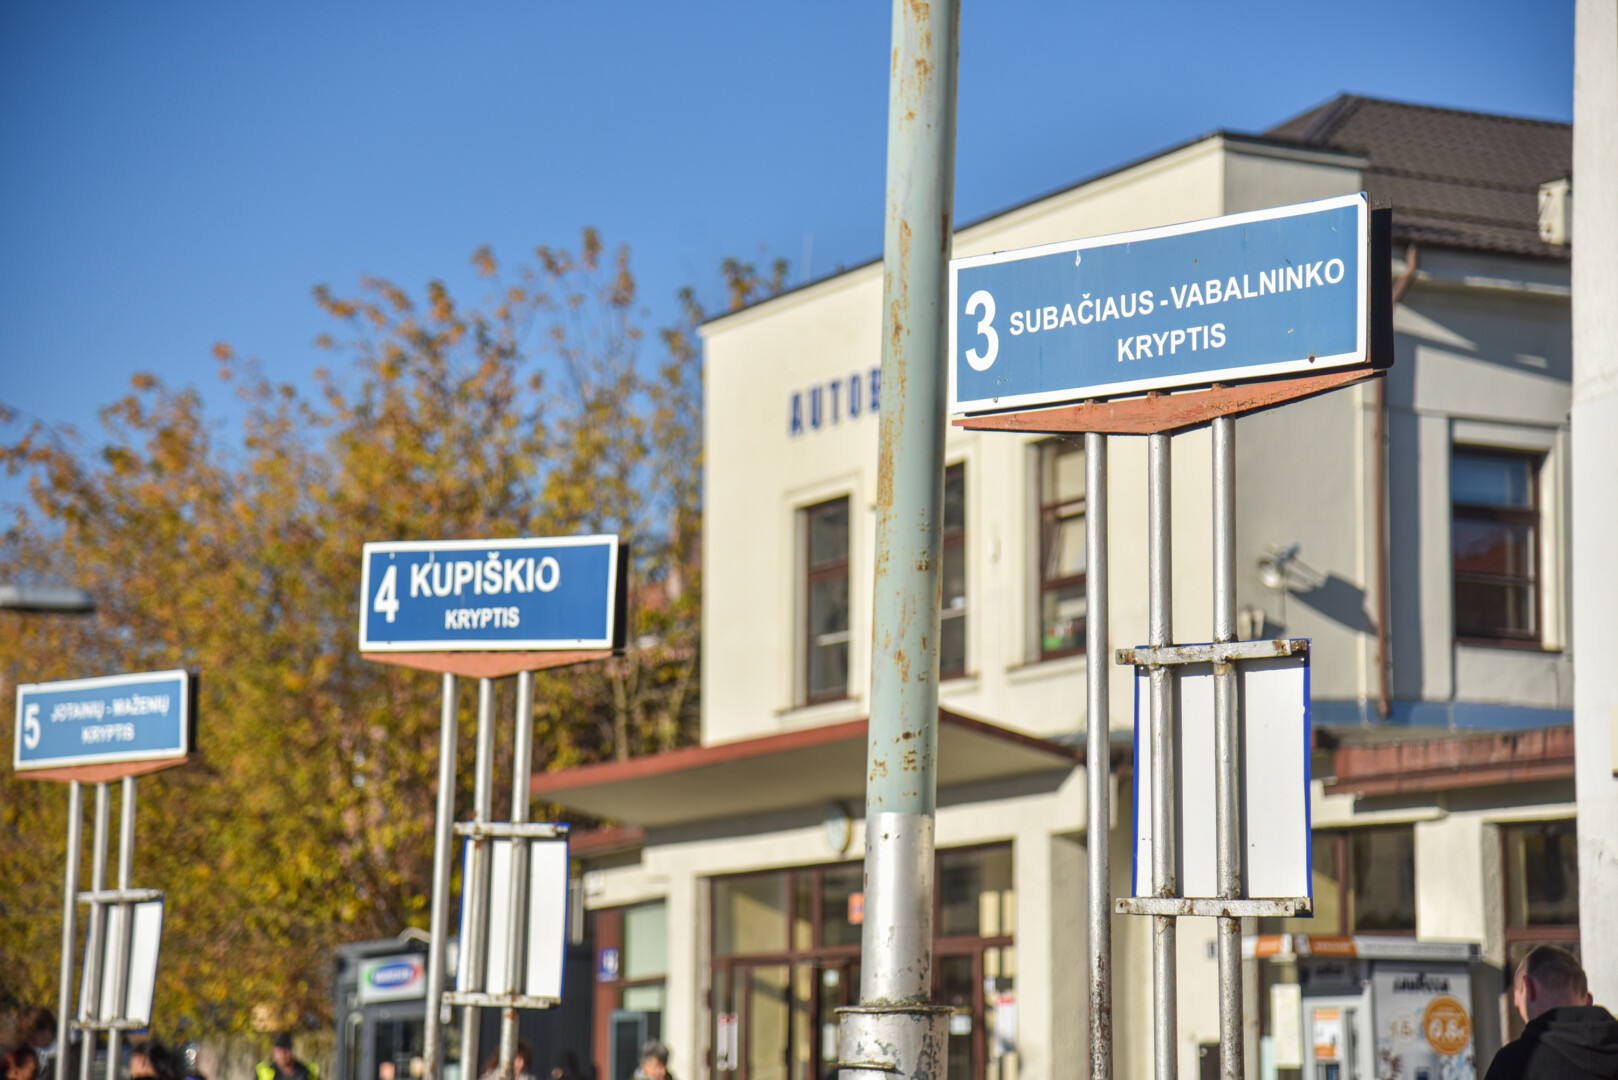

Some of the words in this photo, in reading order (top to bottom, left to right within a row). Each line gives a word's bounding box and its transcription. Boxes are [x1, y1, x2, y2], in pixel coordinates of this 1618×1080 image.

[964, 289, 1000, 371] 3
[1117, 322, 1227, 362] KRYPTIS
[374, 564, 399, 623] 4
[410, 551, 560, 597] KUPIŠKIO
[445, 606, 520, 630] KRYPTIS
[24, 703, 41, 750] 5
[81, 722, 135, 743] KRYPTIS
